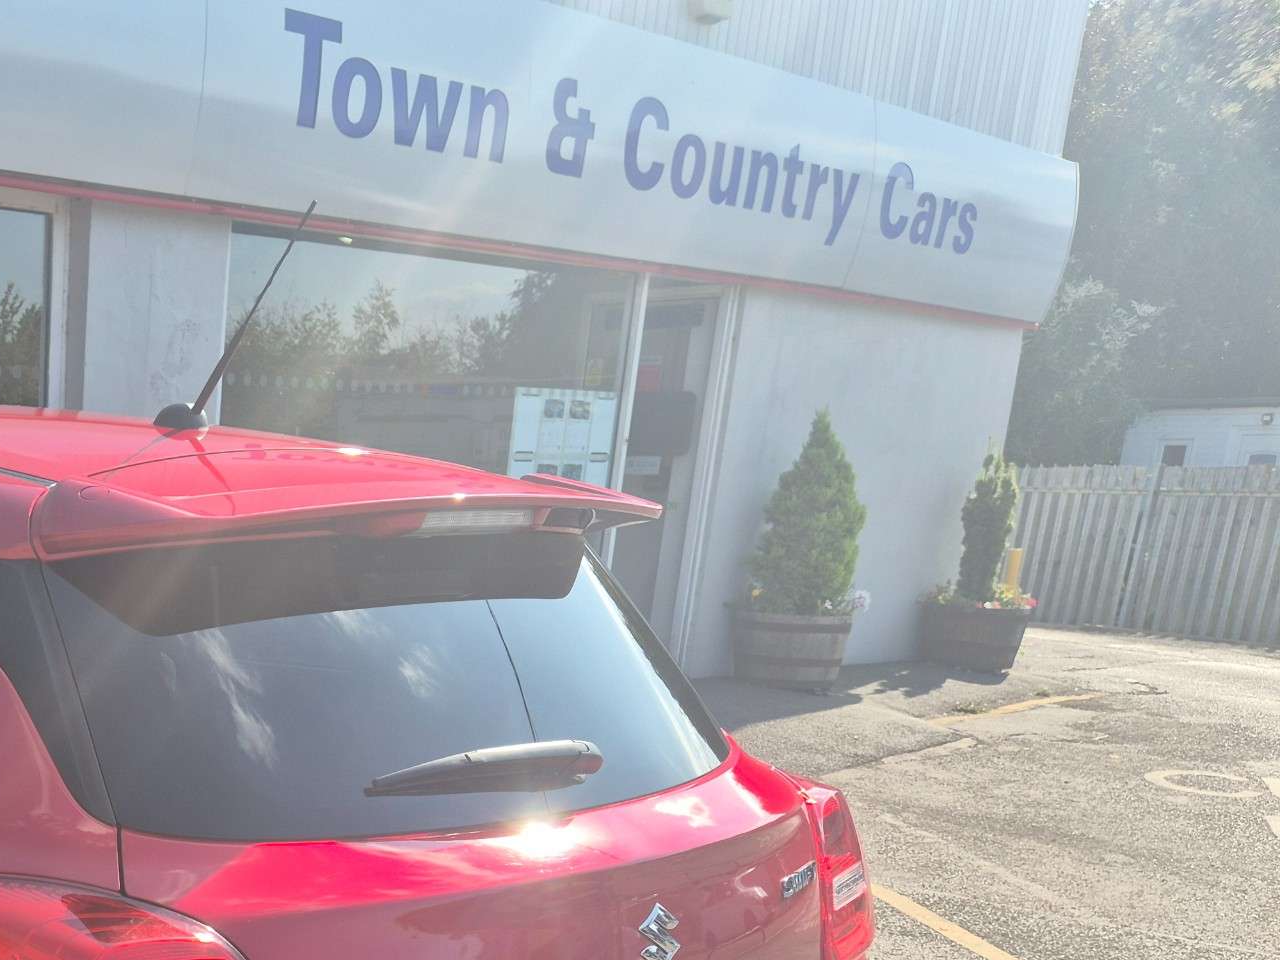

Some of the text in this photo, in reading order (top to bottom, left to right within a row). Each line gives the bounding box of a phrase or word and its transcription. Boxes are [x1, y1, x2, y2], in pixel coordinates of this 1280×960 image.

[284, 8, 978, 255] Town & Country Cars
